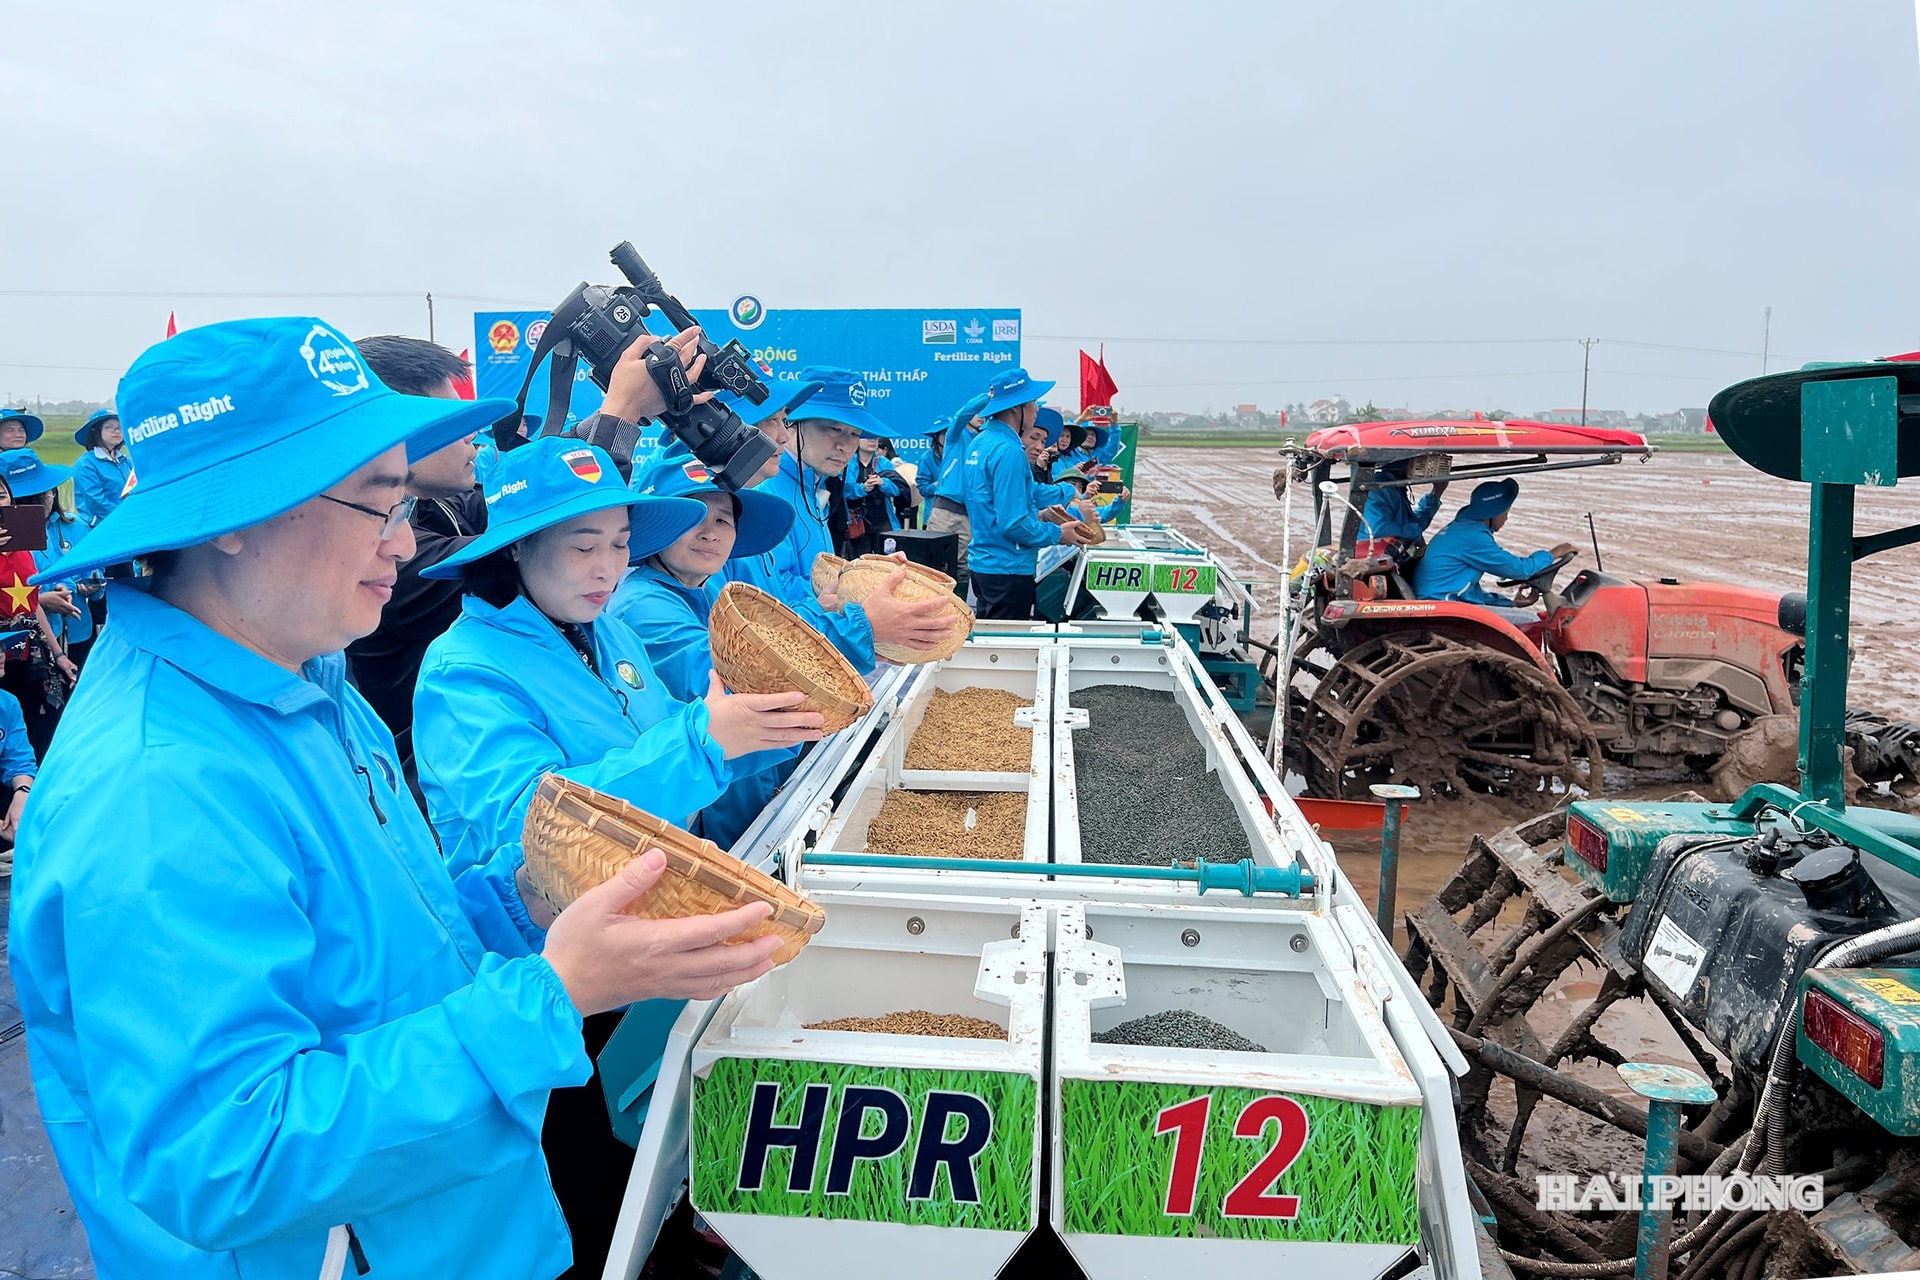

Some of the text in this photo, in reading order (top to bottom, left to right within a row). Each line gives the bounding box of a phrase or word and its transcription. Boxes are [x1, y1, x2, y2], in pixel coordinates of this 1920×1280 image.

[616, 308, 629, 320] 25
[924, 321, 955, 331] USDA
[994, 326, 1017, 335] IRRI
[934, 352, 1012, 363] Fertilize Right
[862, 368, 892, 381] THẢI
[896, 368, 928, 381] THẤP
[866, 388, 891, 399] TRỌT
[127, 394, 235, 446] Fertilize Right
[1411, 426, 1457, 436] KUBOTA
[501, 479, 528, 497] Right
[1095, 566, 1199, 591] HPR 12
[735, 1080, 1311, 1222] HPR 12
